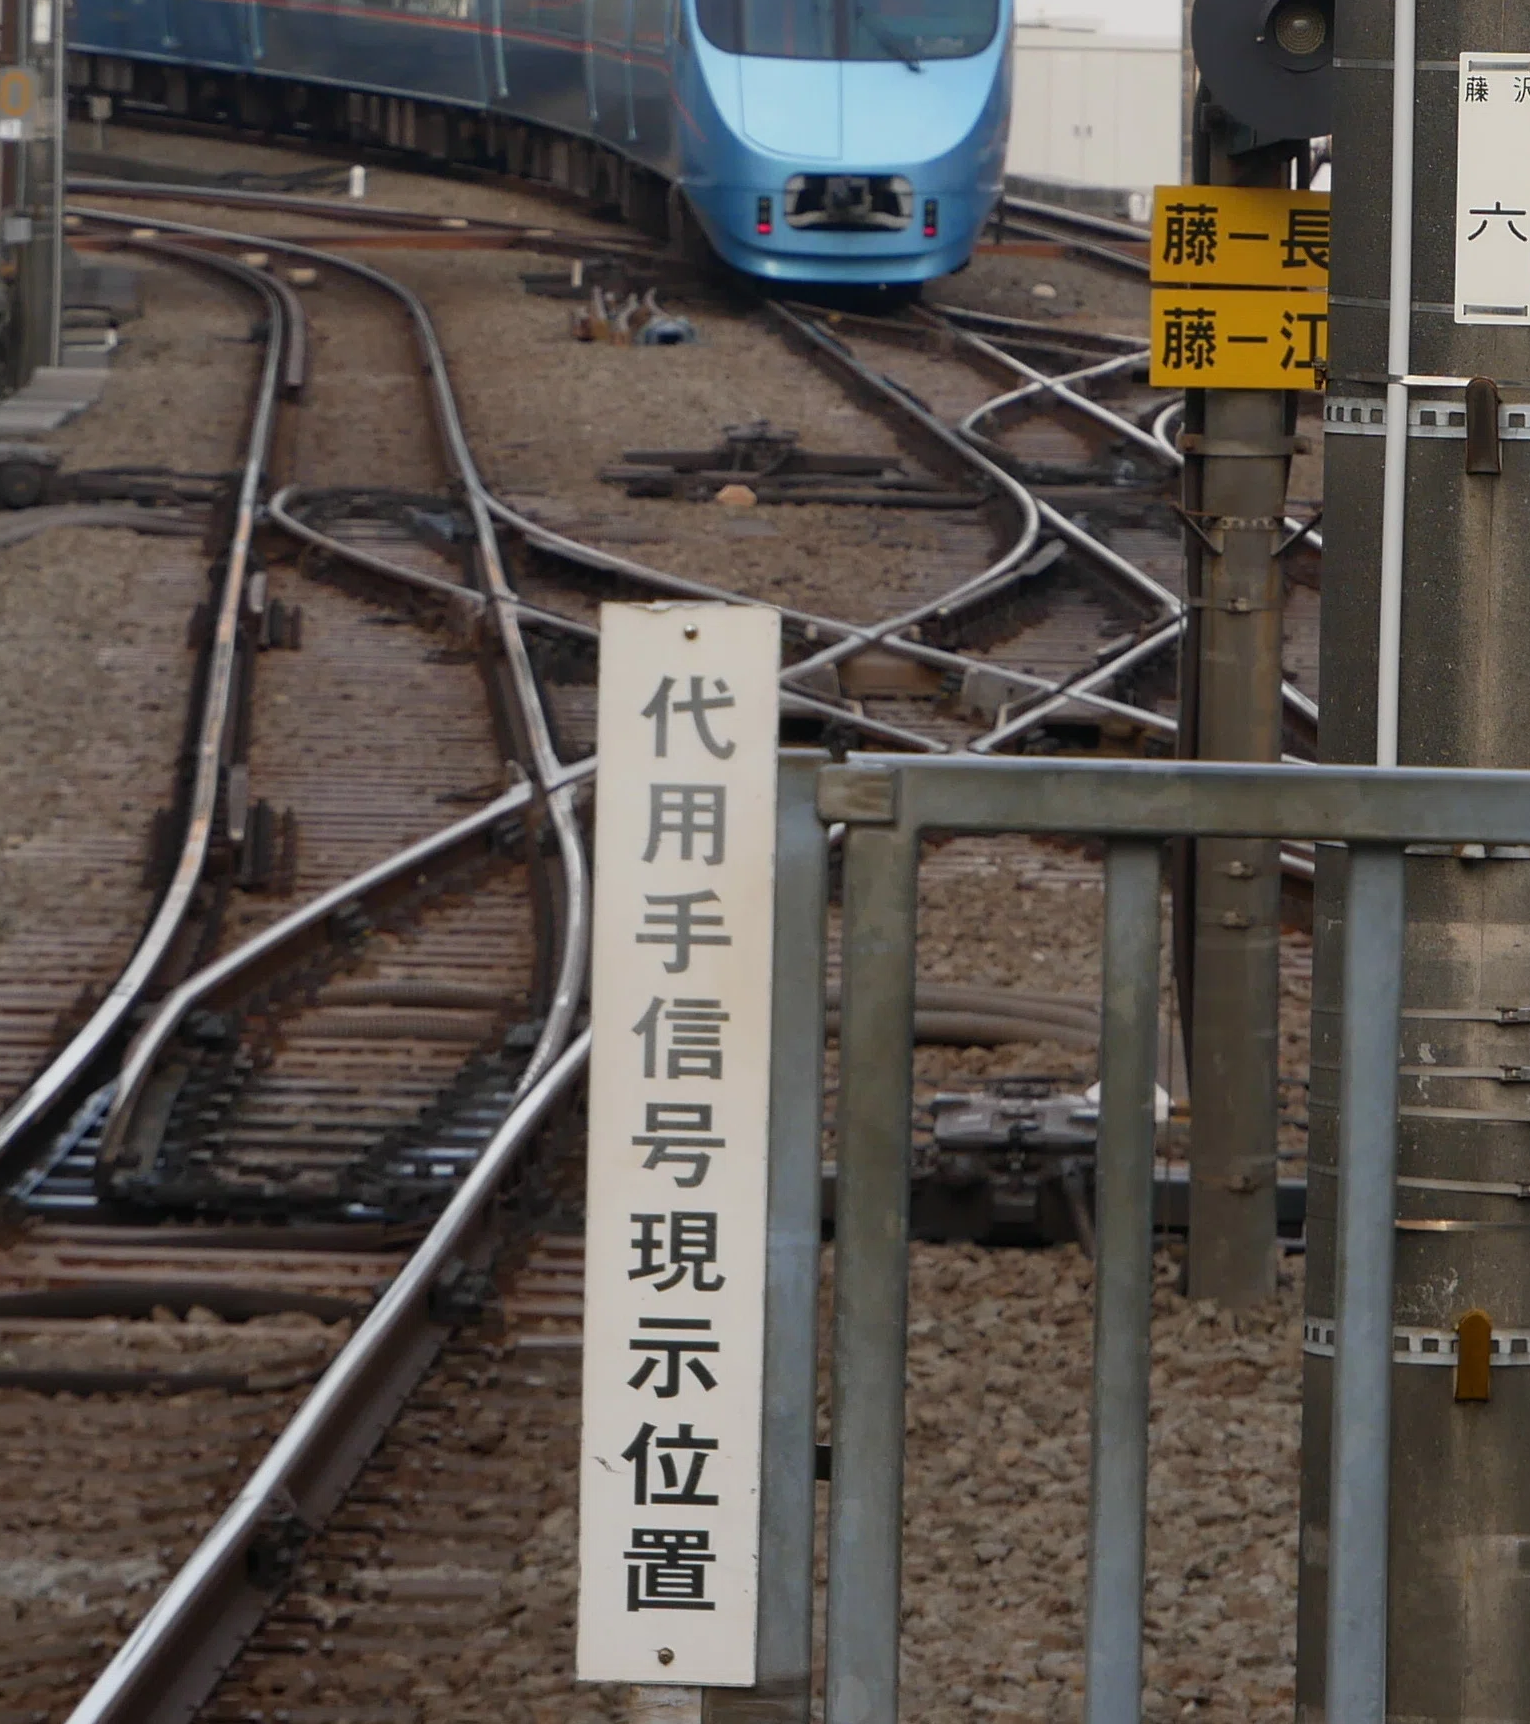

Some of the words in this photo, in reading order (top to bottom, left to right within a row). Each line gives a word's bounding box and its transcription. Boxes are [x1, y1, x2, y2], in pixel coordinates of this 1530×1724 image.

[1467, 200, 1529, 243] 六
[620, 674, 738, 1616] 代用手信号現示位置
